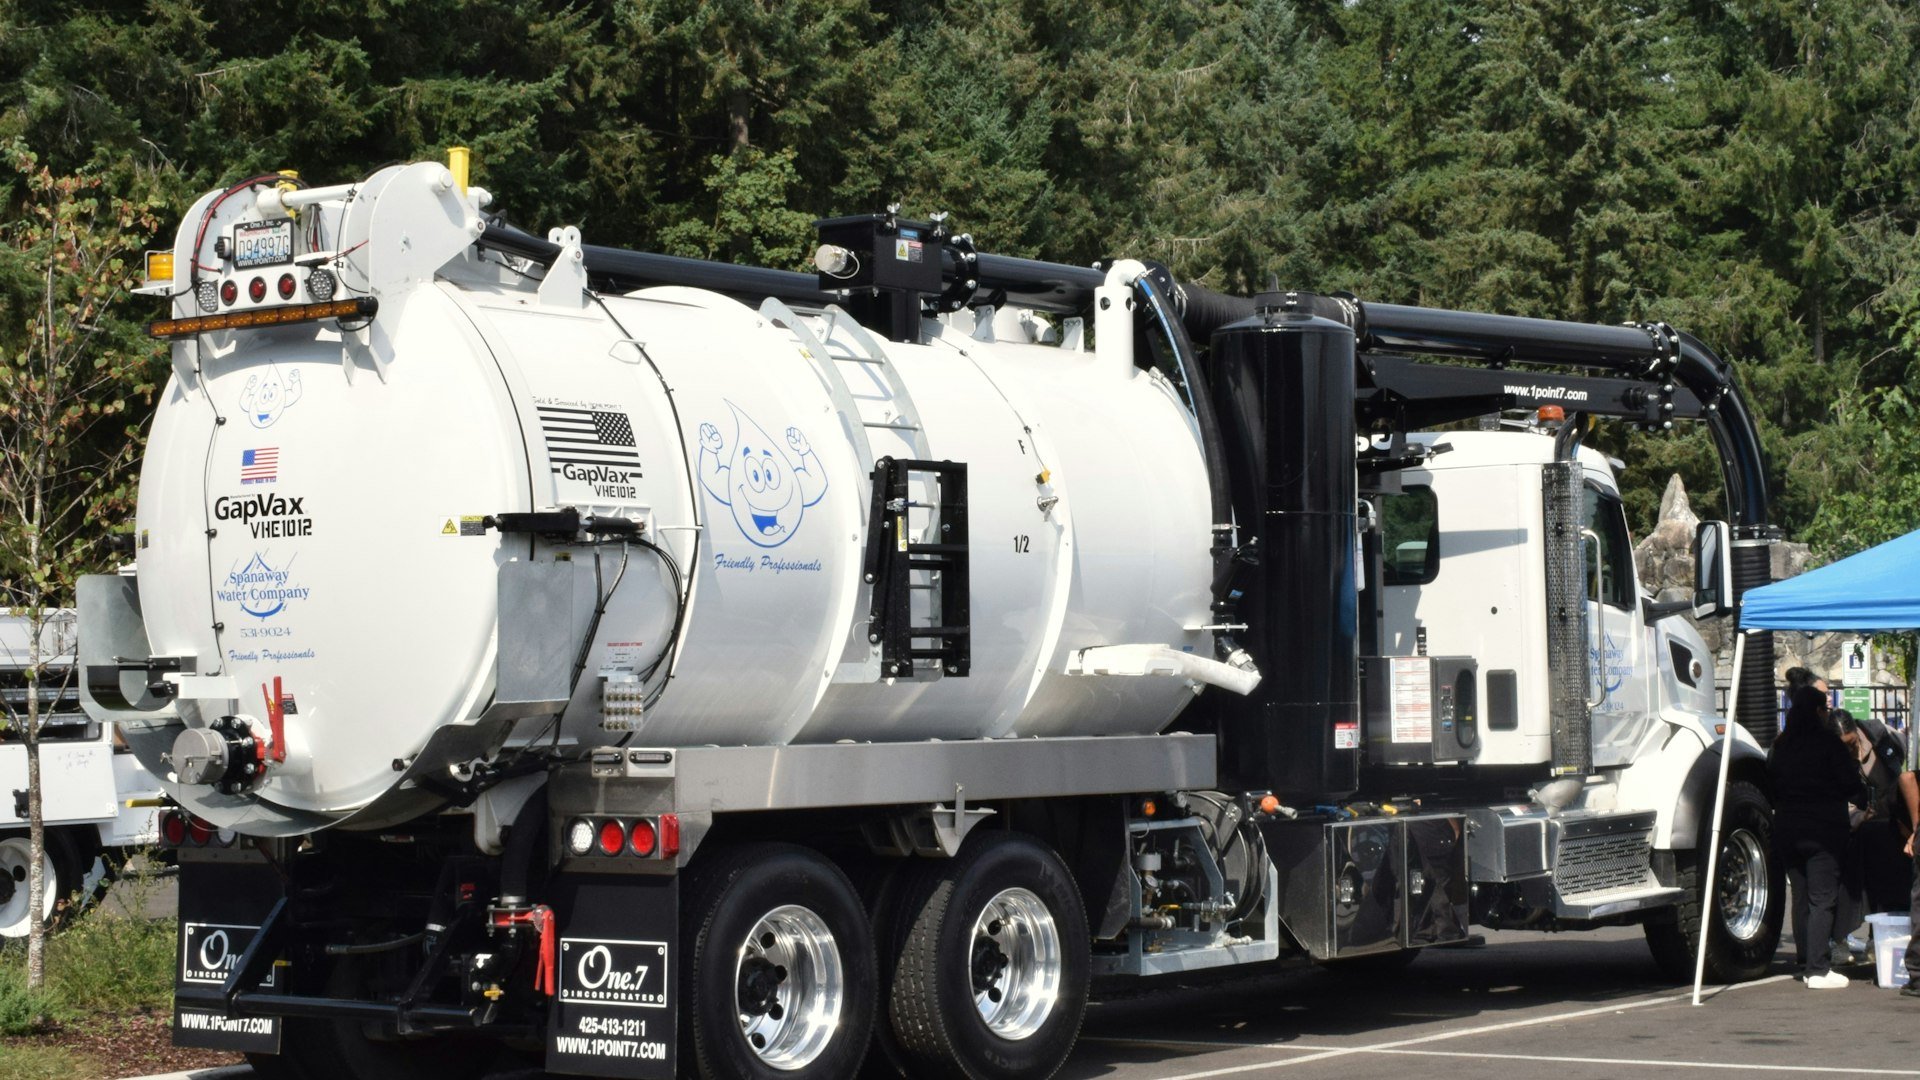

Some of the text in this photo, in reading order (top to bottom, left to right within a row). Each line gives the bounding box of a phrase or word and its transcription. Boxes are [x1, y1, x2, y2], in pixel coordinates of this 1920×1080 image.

[237, 255, 288, 267] WWW.1POINT7.COM
[1503, 385, 1588, 401] www.1point7.com
[562, 463, 630, 486] GapVax
[594, 484, 637, 499] VHE1012
[214, 493, 305, 525] GapVax
[250, 518, 312, 539] VHE1012
[1013, 534, 1030, 554] 1/2
[714, 553, 822, 573] Friendly Professionals
[229, 569, 290, 587] Spanaway
[216, 587, 310, 602] Water Company
[240, 627, 292, 639] 531-9024
[228, 648, 316, 663] Friendly Professionals
[1590, 647, 1624, 661] Spnaway
[577, 945, 649, 991] One.7
[571, 990, 655, 1002] INCORPORATED
[180, 1013, 273, 1035] WWW.1POINT7.COM
[578, 1016, 646, 1037] 425-413-1211
[556, 1036, 666, 1060] WWW.1POINT7.COM
